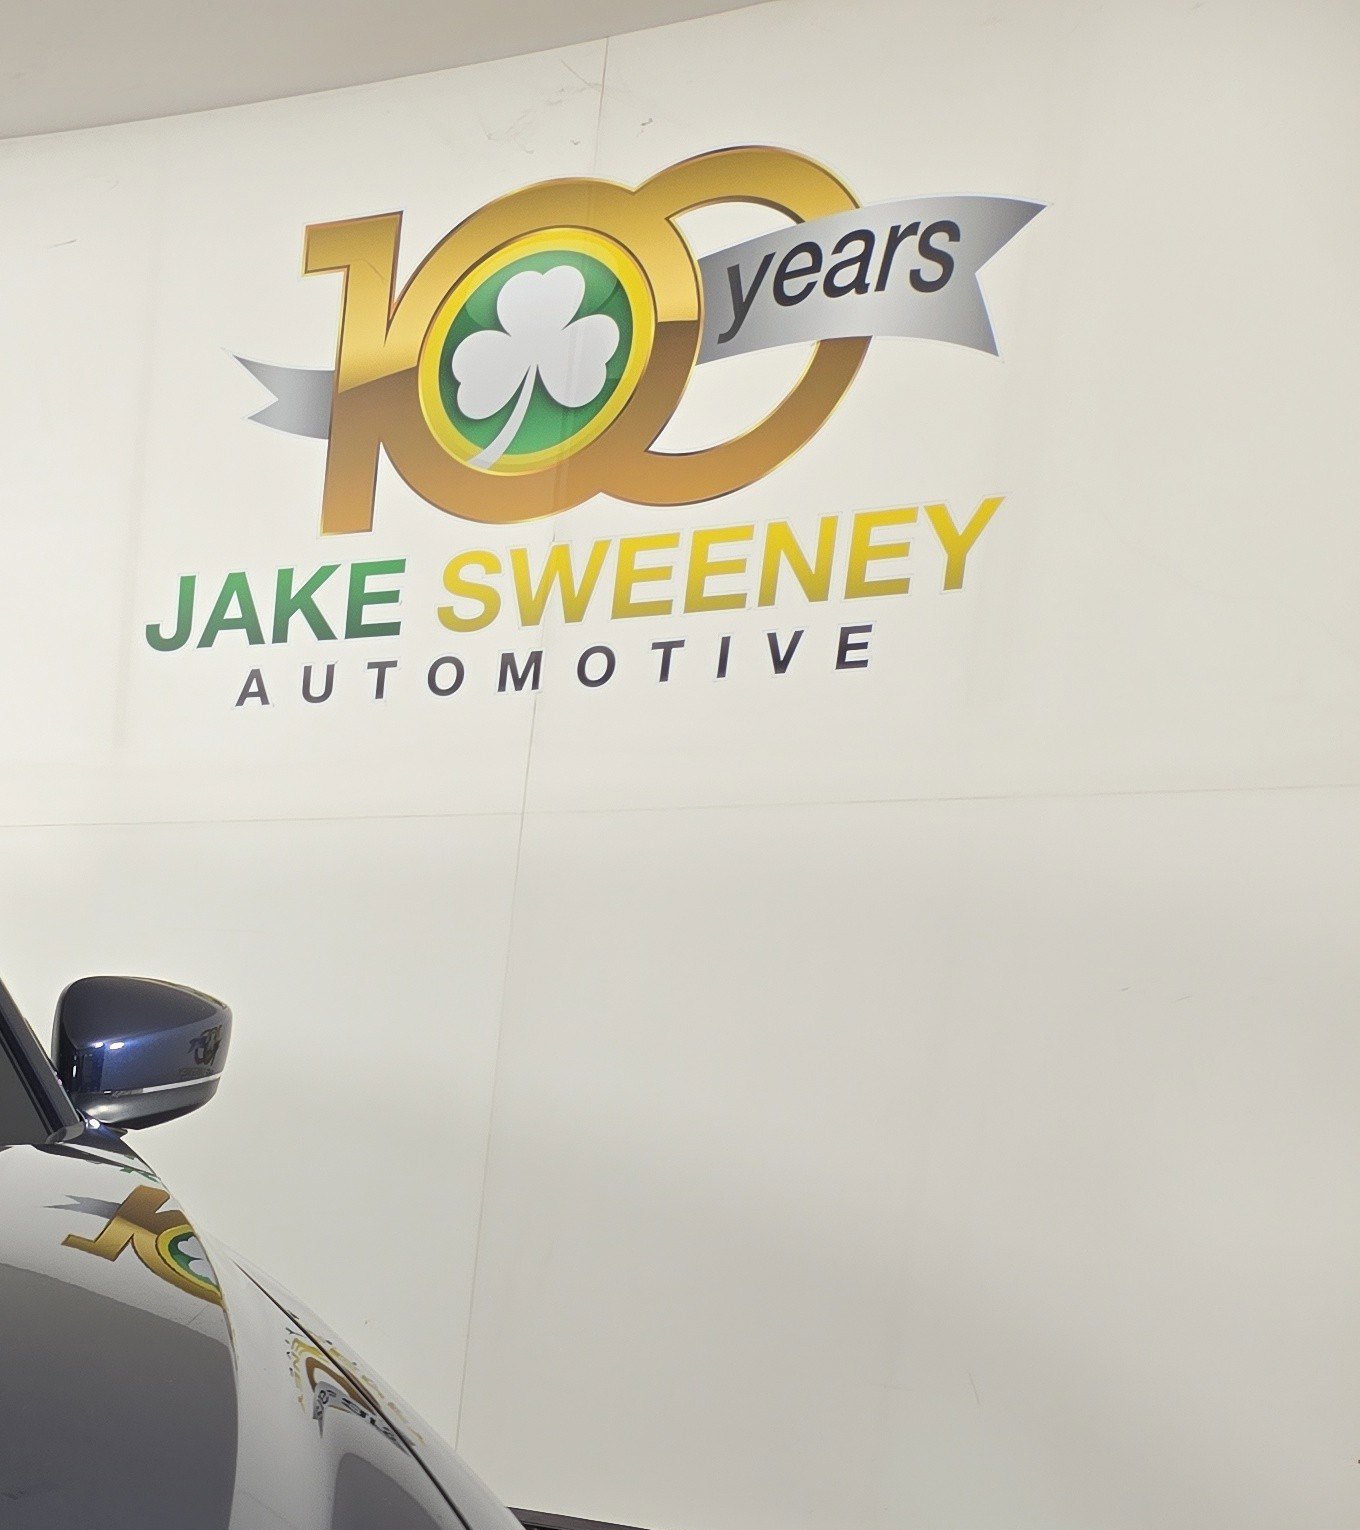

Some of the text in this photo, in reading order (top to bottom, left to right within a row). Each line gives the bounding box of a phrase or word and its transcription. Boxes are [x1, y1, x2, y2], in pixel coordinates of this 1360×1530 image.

[304, 143, 872, 536] 100
[717, 218, 960, 345] years
[144, 496, 1005, 653] JAKE SWEENEY
[235, 624, 873, 707] AUTOMOTIVE
